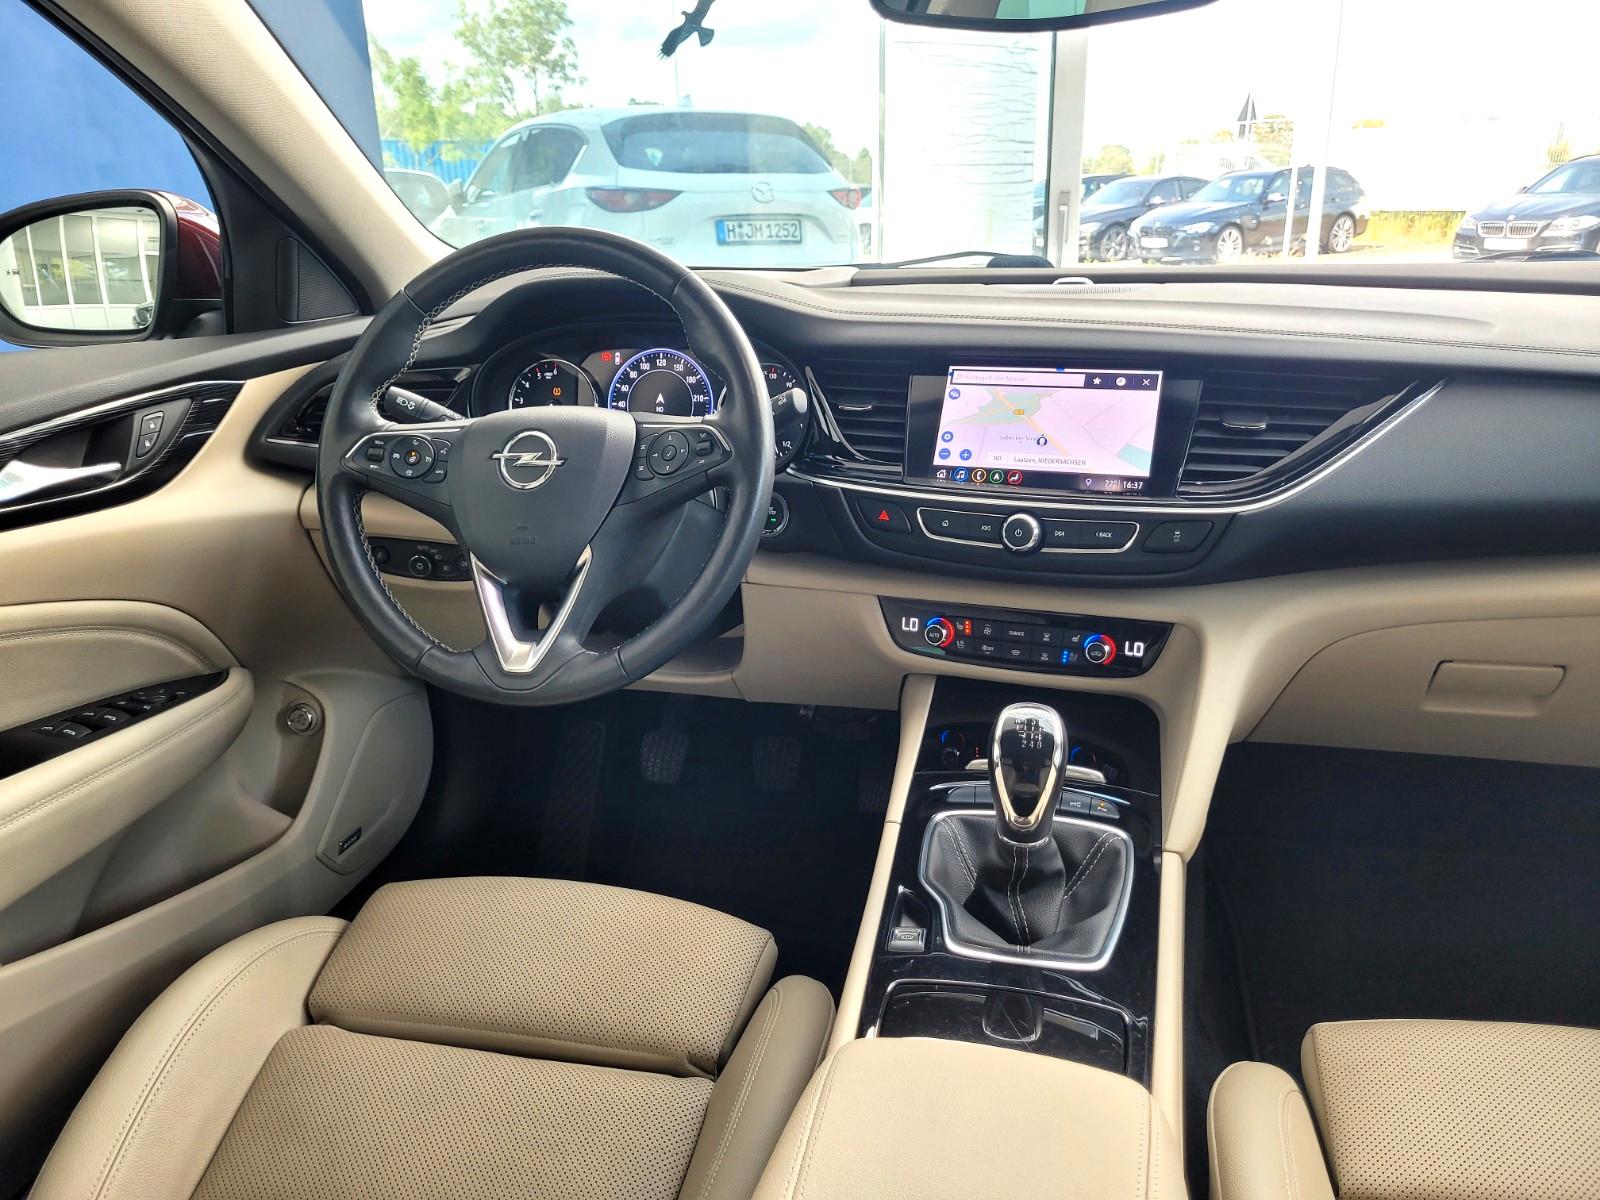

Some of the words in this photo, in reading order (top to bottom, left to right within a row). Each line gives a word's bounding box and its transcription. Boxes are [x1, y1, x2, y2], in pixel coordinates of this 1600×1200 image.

[726, 224, 736, 240] H
[746, 224, 763, 238] JM
[766, 223, 799, 238] 1252
[640, 362, 650, 370] 100
[656, 359, 667, 367] 120
[673, 364, 684, 372] 150
[630, 370, 638, 378] 80
[686, 376, 696, 384] 180
[620, 384, 629, 392] 60
[618, 400, 626, 408] 40
[1122, 480, 1143, 490] 16:37
